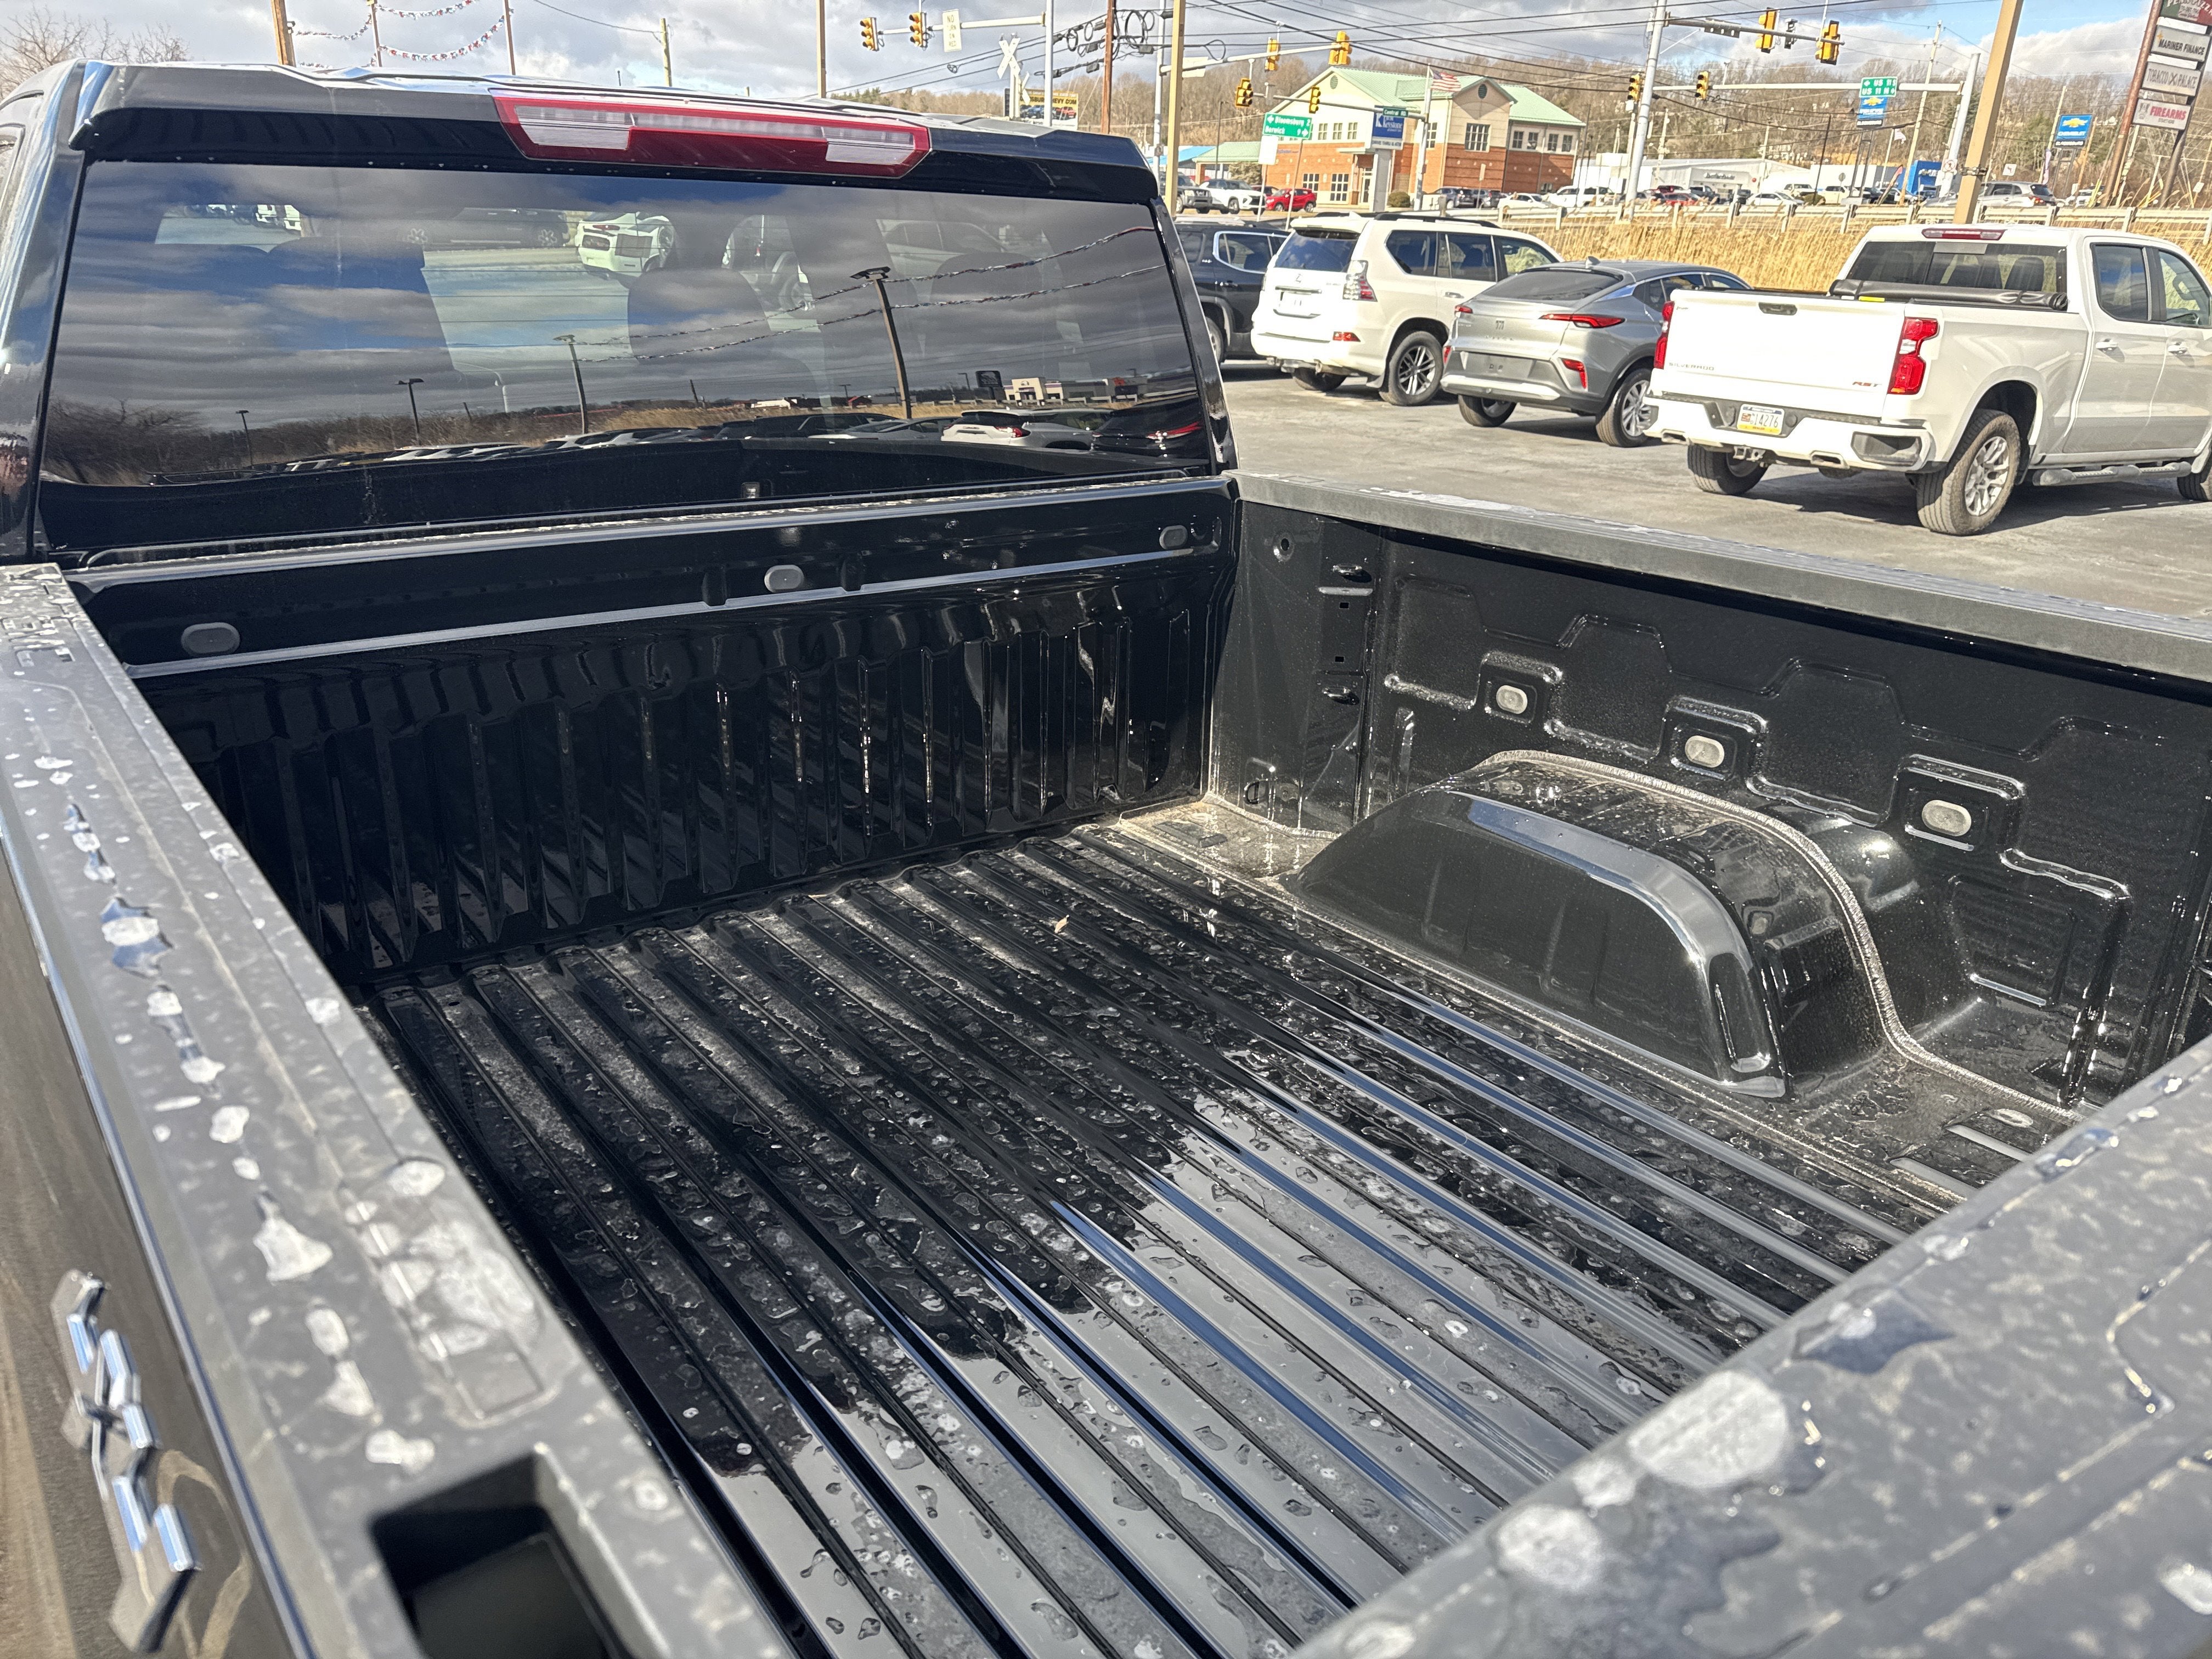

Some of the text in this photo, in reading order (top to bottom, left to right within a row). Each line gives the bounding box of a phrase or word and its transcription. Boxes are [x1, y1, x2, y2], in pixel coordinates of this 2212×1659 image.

[947, 14, 954, 23] NO
[2158, 39, 2205, 55] MARINER FINANCE
[2147, 68, 2198, 88] TOBACCO PALACE
[2150, 106, 2187, 120] FIREARMS
